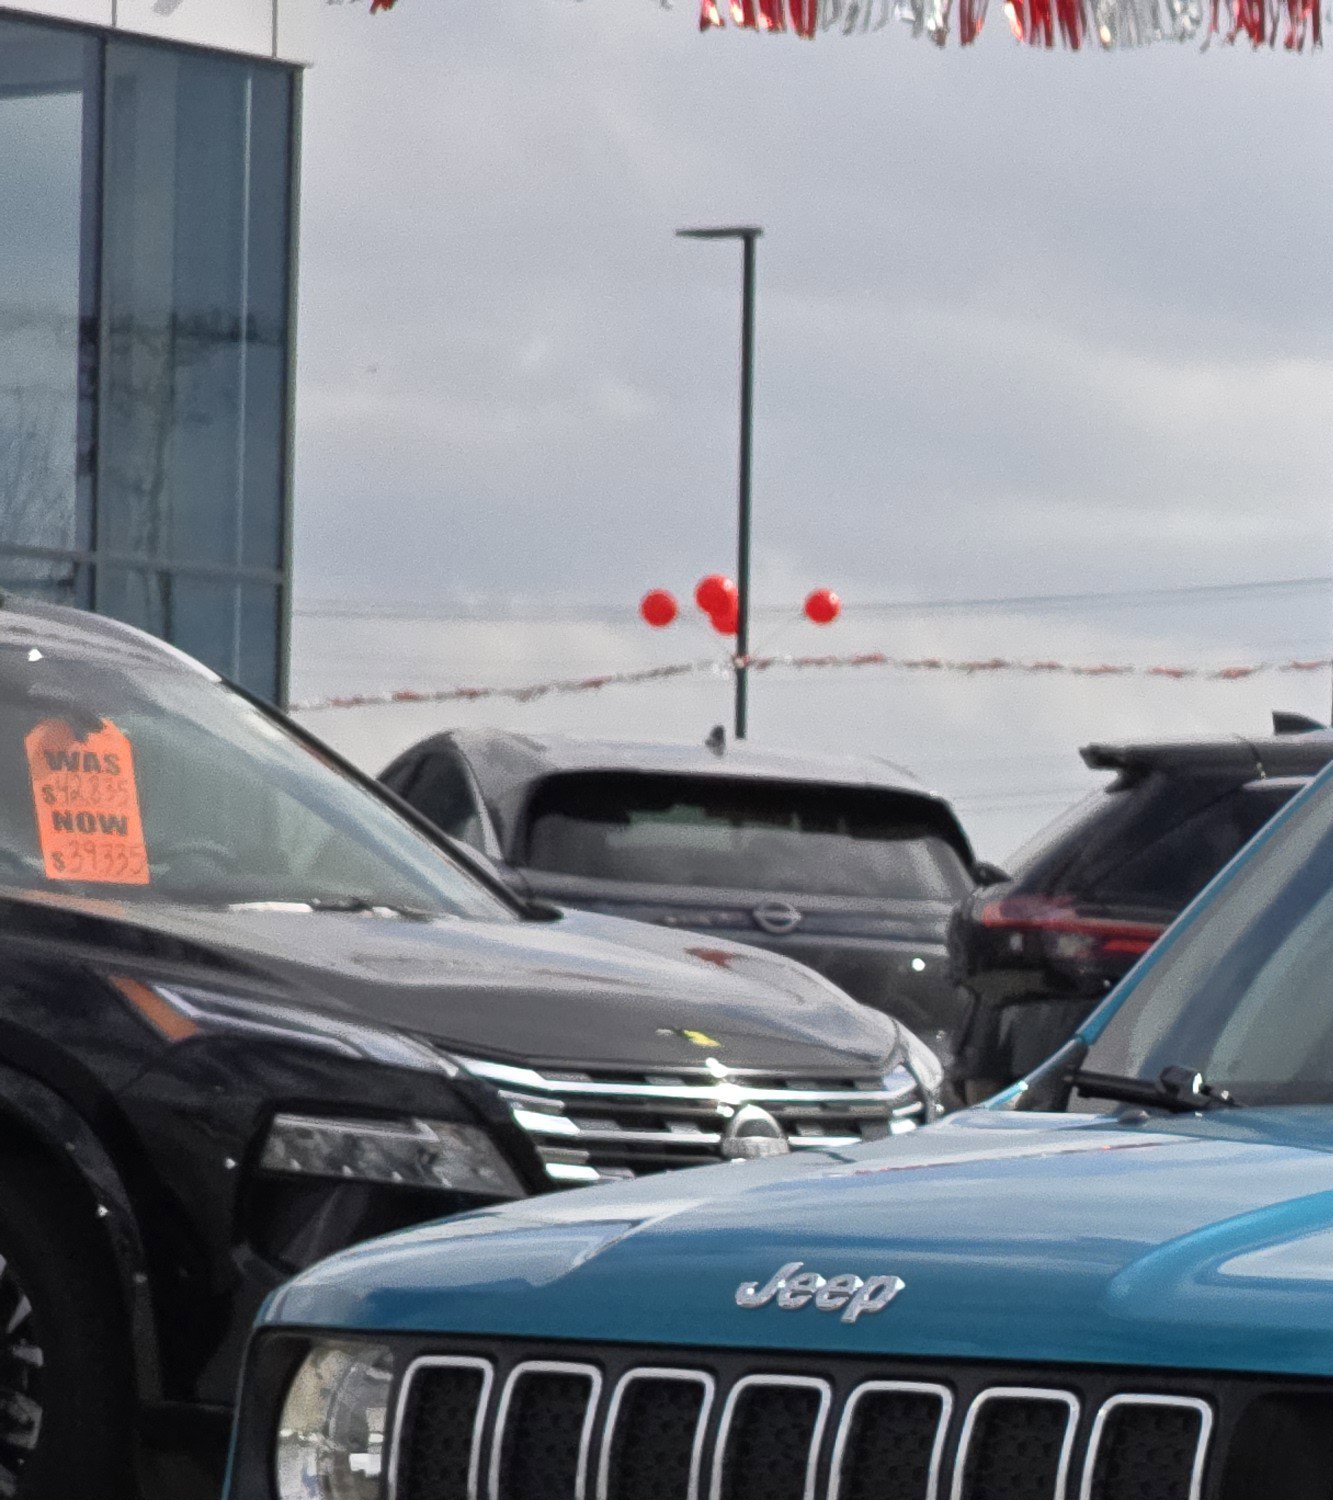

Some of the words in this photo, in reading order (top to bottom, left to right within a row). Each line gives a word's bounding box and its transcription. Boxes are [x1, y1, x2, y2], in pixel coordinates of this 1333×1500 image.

[43, 750, 121, 775] WAS
[52, 809, 129, 836] NOW
[735, 1261, 906, 1323] Jeep
